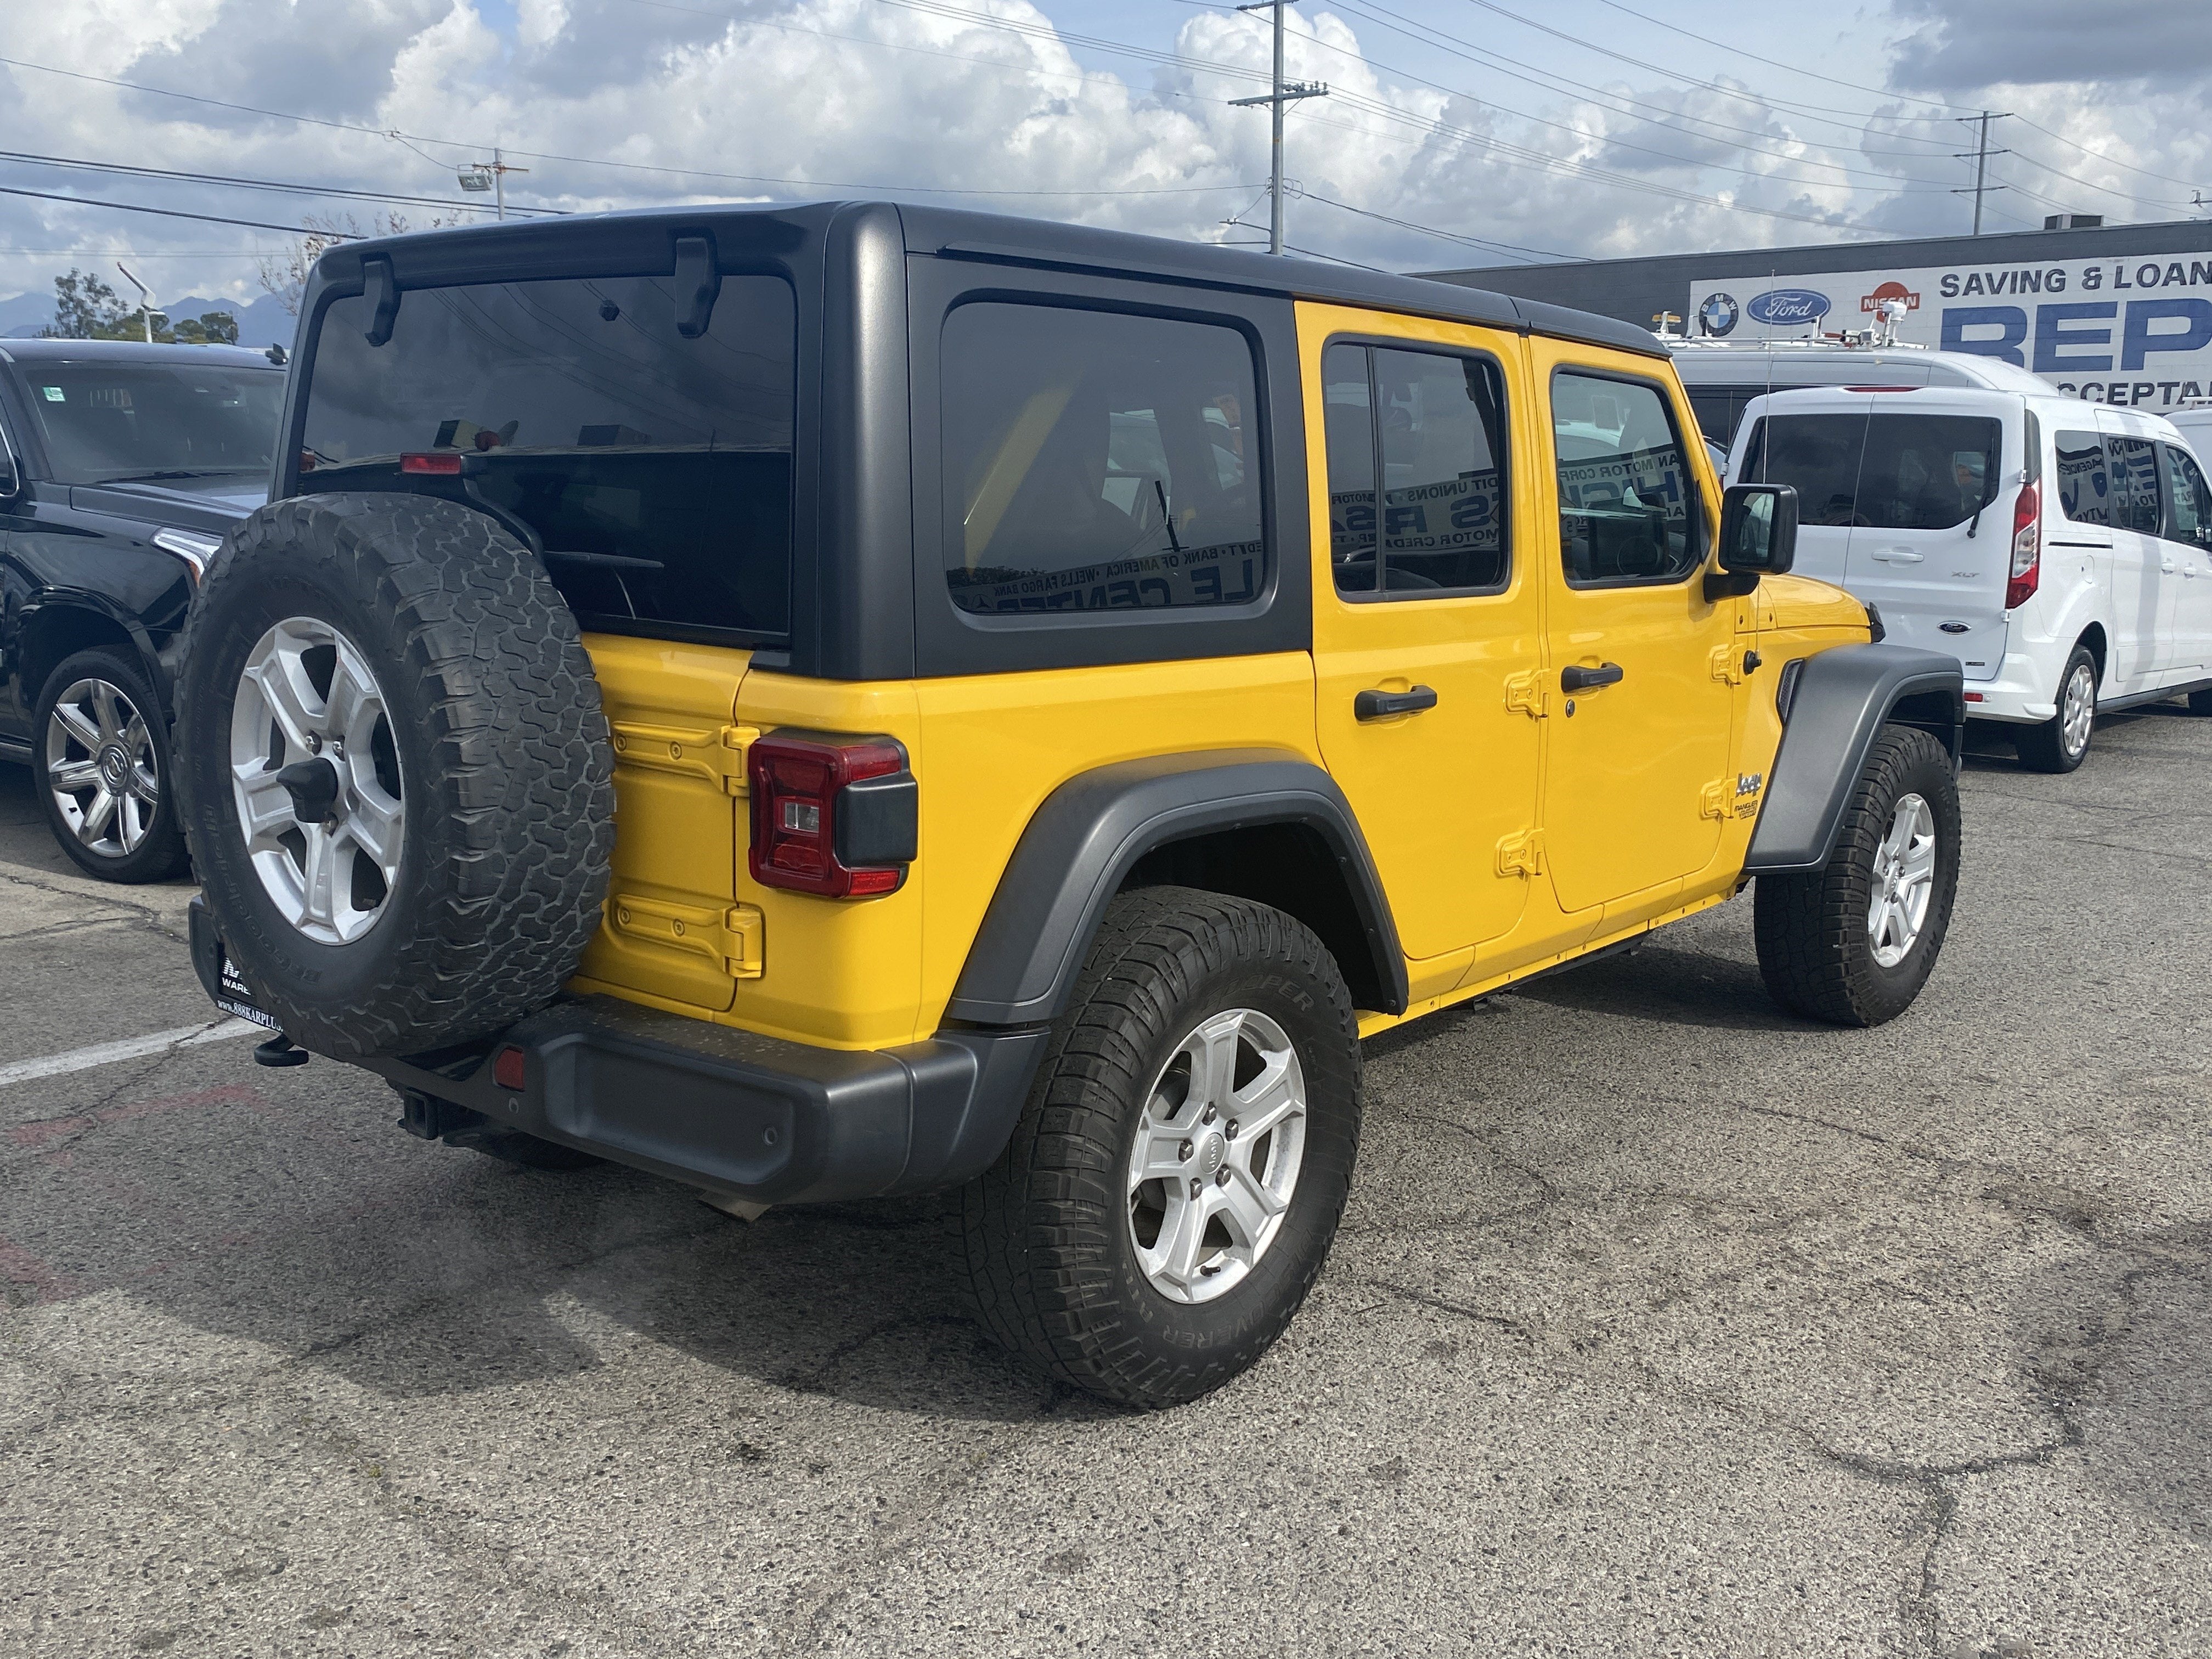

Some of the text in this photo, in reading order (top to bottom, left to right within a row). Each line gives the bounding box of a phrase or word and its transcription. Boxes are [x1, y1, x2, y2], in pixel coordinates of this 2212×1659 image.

[1939, 261, 2212, 298] SAVING & LOAN
[1701, 294, 1737, 312] BMW
[1765, 296, 1812, 317] Ford
[1864, 296, 1916, 309] NISAN
[1939, 298, 2212, 373] REP
[2058, 380, 2212, 405] CCEPTA
[1735, 772, 1762, 798] Jeep
[222, 977, 251, 996] WARE
